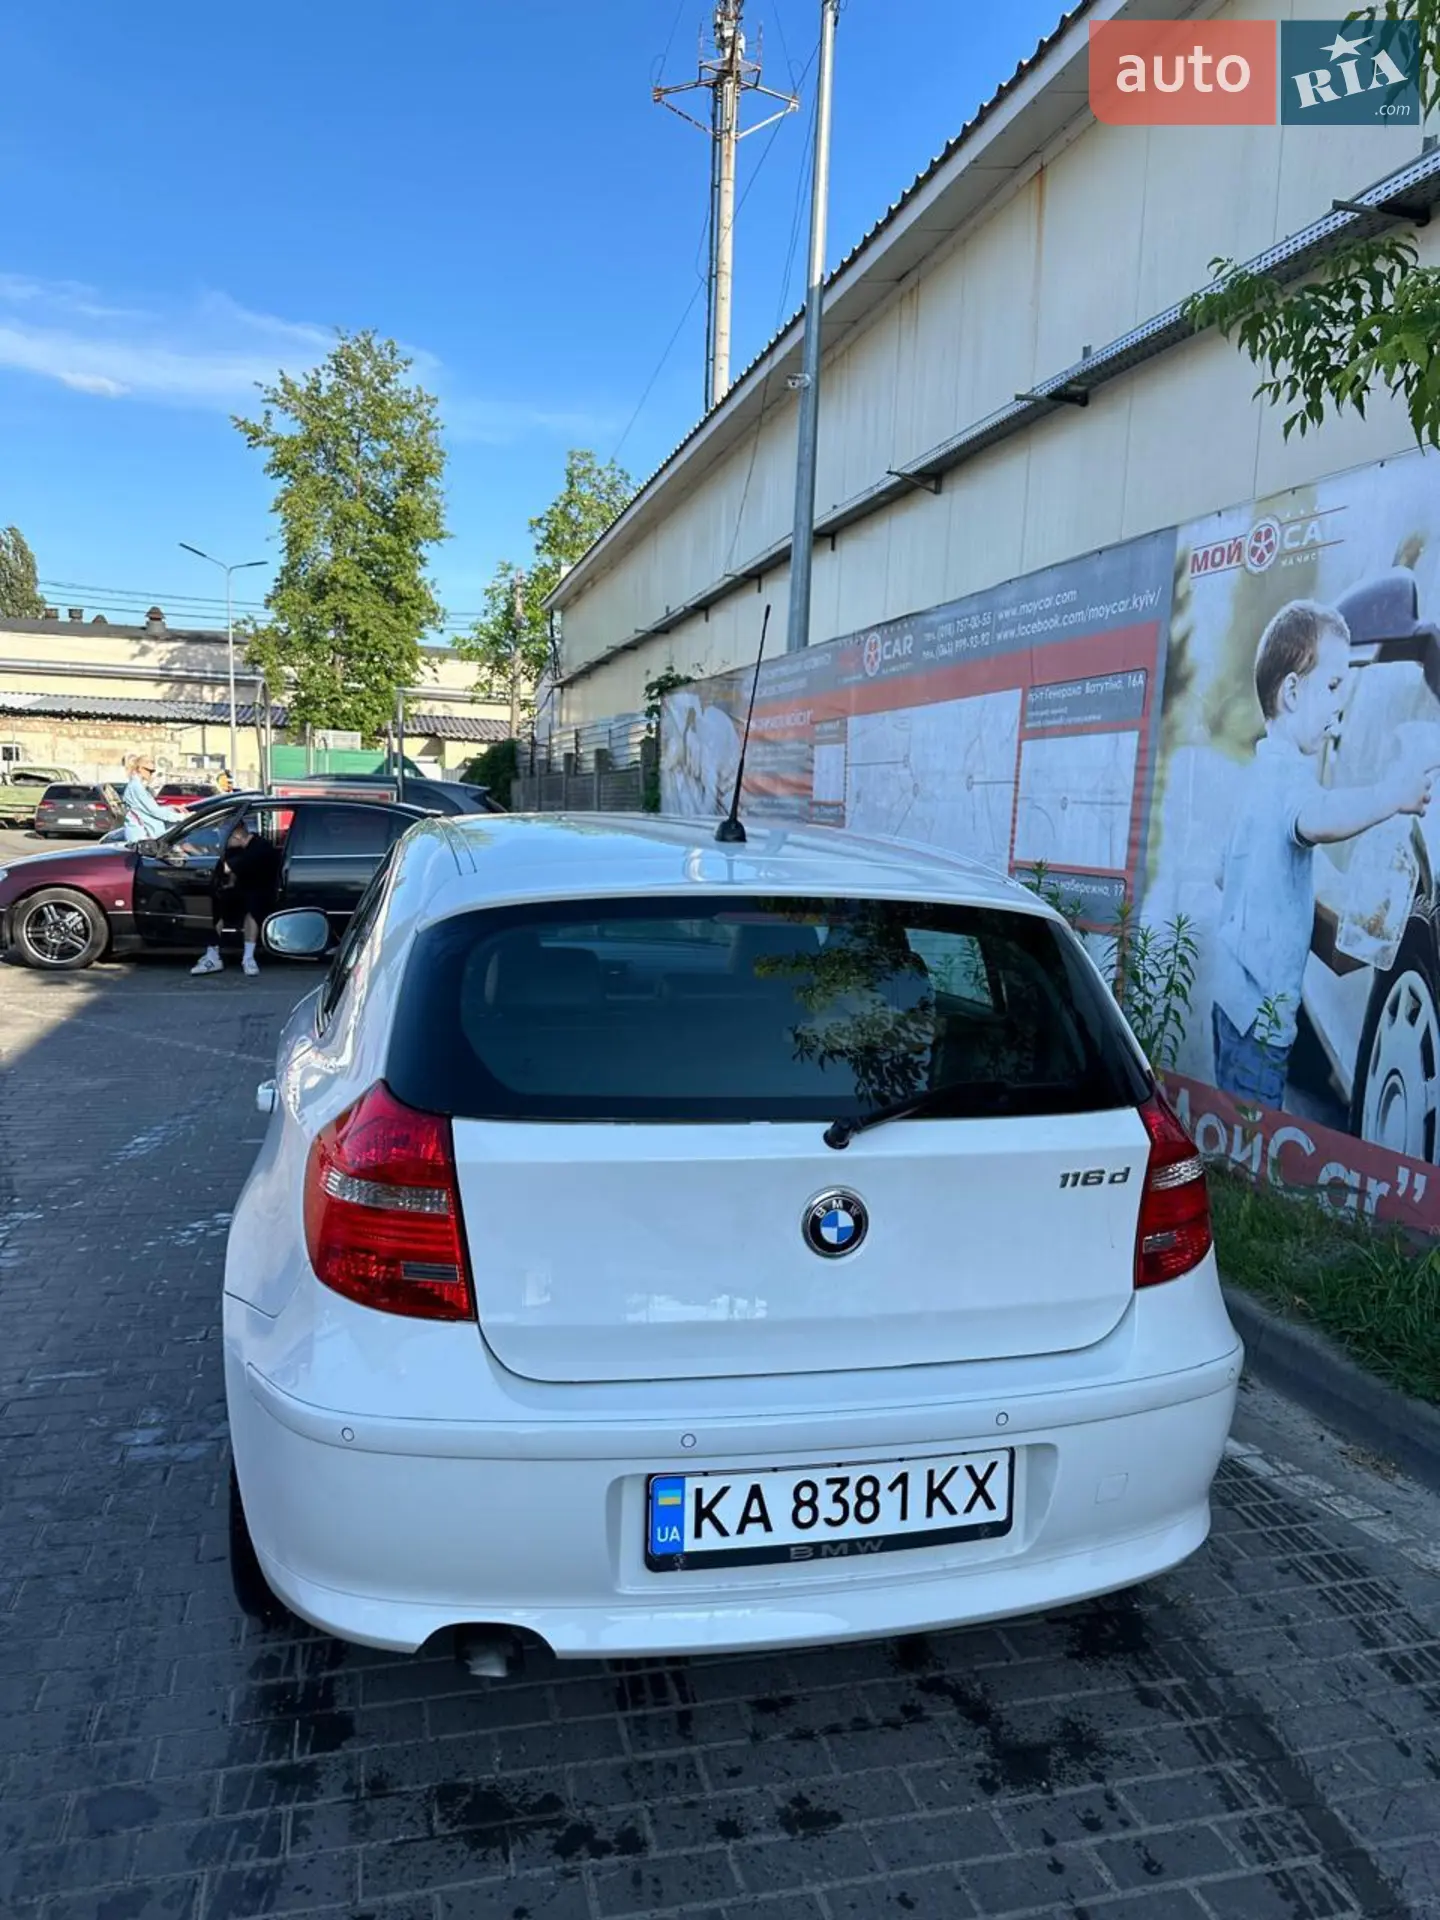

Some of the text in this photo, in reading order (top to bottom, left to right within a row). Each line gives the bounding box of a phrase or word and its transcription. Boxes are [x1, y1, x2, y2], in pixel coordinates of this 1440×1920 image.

[1190, 537, 1243, 574] МОЙ
[998, 589, 1077, 620] www.moycar.com
[883, 634, 914, 660] CAR
[1059, 1166, 1131, 1189] 116d
[815, 1199, 861, 1218] BMW
[694, 1460, 999, 1539] KA 8381 KX
[657, 1525, 681, 1543] UA
[789, 1539, 884, 1560] BMW
